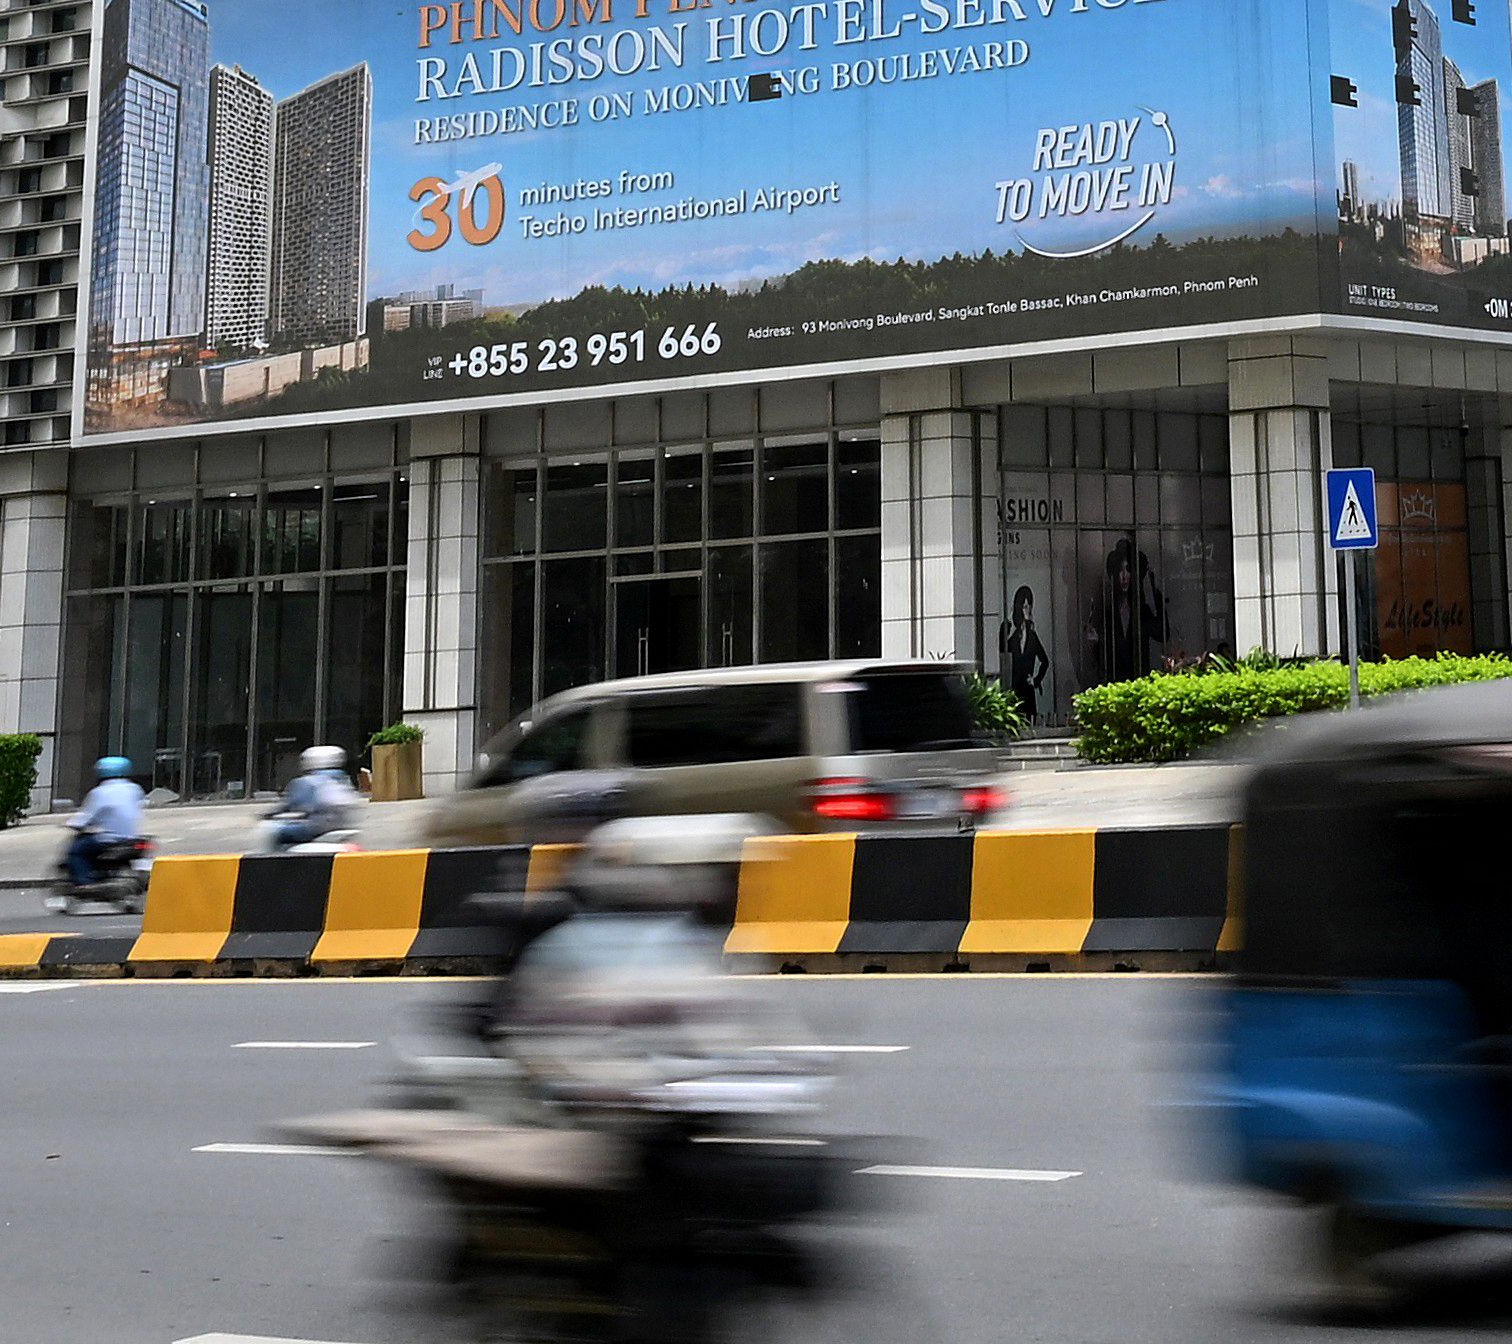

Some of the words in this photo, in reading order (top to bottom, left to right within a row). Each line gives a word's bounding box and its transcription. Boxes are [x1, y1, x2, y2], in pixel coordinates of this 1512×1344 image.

[414, 99, 578, 145] RESIDENCE
[588, 91, 634, 122] ON
[643, 67, 820, 115] MONIVNG
[830, 39, 1030, 91] BOULEVARD
[415, 22, 688, 102] RADISSON
[1033, 116, 1141, 172] READY
[406, 172, 506, 252] 30
[518, 213, 587, 240] Techo
[593, 190, 746, 232] International
[752, 180, 840, 216] Airport
[519, 178, 611, 206] minutes
[618, 169, 674, 194] from
[994, 179, 1035, 224] TO
[1039, 166, 1134, 219] MOVE
[1139, 161, 1176, 206] IN
[747, 325, 795, 340] Address:
[801, 321, 817, 334] 93
[819, 318, 874, 333] Monivong
[876, 309, 936, 327] Boulevard,
[938, 303, 984, 321] Sangkat
[987, 300, 1017, 315] Tonle
[1020, 296, 1064, 312] Bassac,
[1066, 292, 1097, 307] Khan
[1099, 284, 1181, 303] Chamkarmon,
[1184, 279, 1225, 294] Phnom
[1228, 274, 1259, 289] Penh
[1348, 283, 1367, 297] UNIT
[1371, 284, 1396, 300] TYPES
[448, 342, 528, 379] +855
[537, 338, 578, 372] 23
[587, 329, 644, 366] 951
[657, 322, 722, 359] 666
